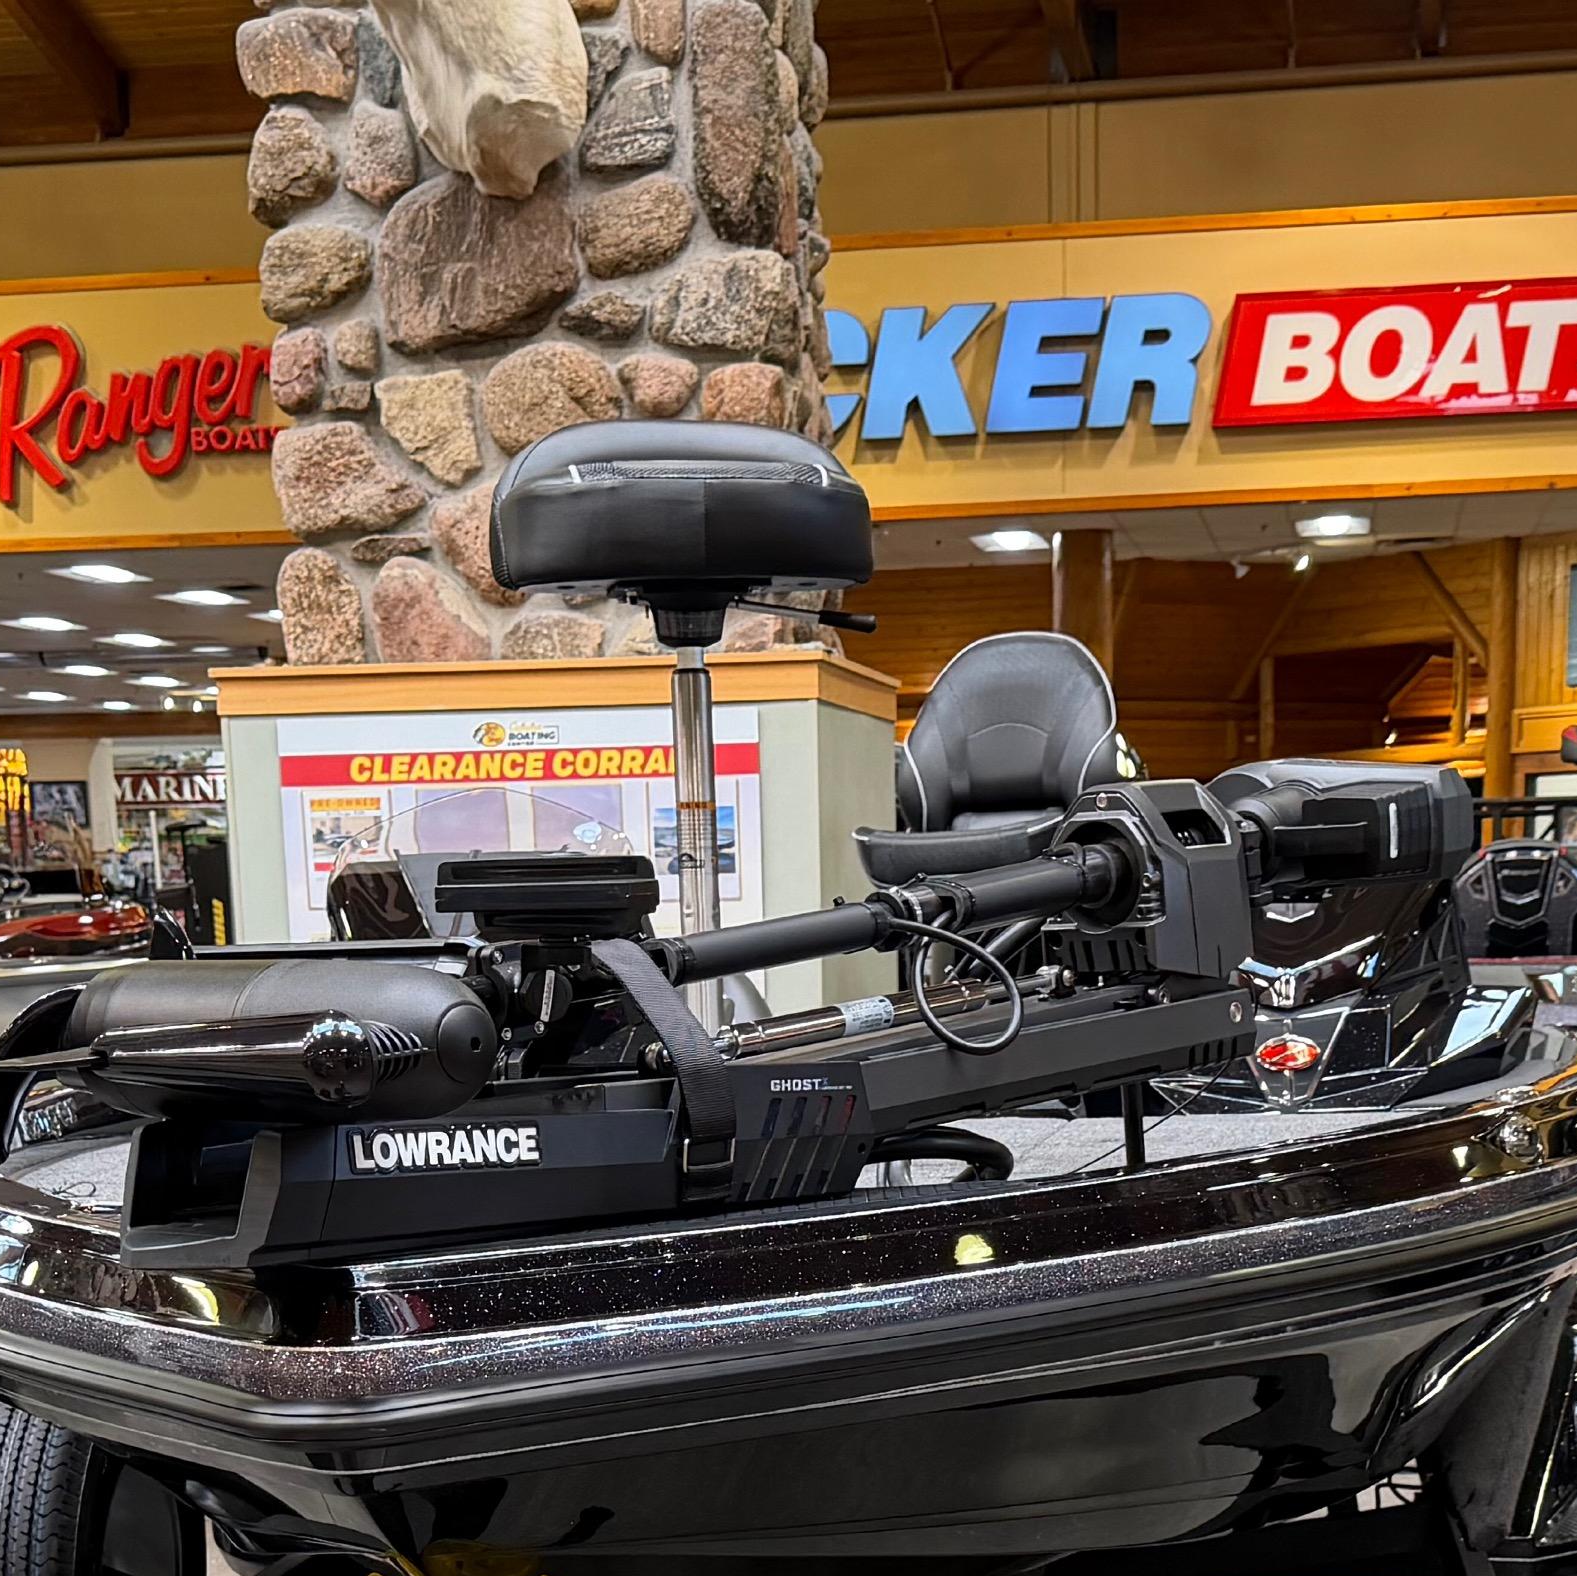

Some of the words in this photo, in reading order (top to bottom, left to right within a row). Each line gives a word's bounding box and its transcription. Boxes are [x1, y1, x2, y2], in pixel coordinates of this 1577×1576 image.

[191, 424, 286, 453] BOAT
[349, 751, 545, 783] CLEARANCE
[770, 1078, 822, 1092] GHOST
[352, 1127, 540, 1169] LOWRANCE
